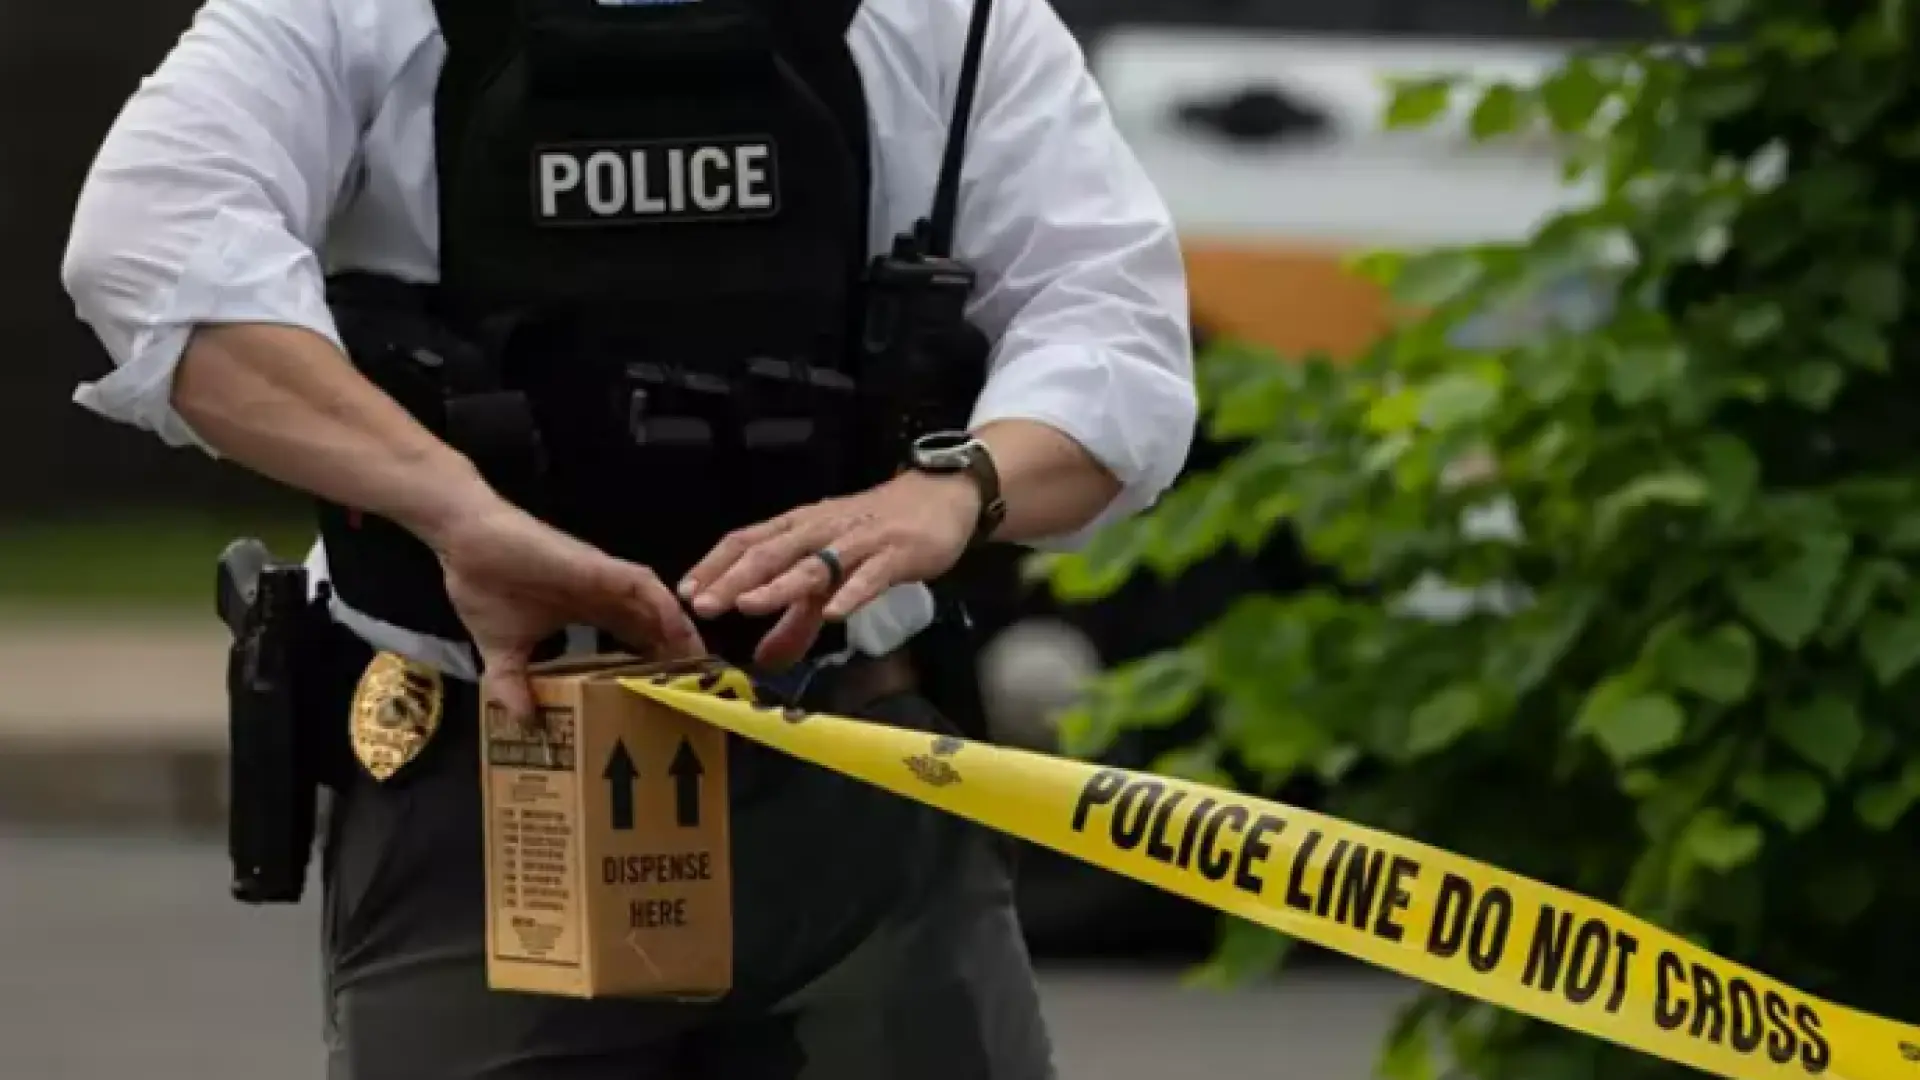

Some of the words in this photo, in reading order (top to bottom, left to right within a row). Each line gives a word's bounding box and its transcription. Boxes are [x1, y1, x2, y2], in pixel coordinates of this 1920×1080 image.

[540, 145, 772, 217] POLICE
[602, 850, 711, 884] DISPENSE
[629, 898, 687, 928] HERE
[1072, 769, 1287, 895] POLICE
[1284, 829, 1422, 943] LINE
[1426, 871, 1513, 974] DO
[1520, 903, 1639, 1013] NOT
[1654, 949, 1830, 1073] CROSS
